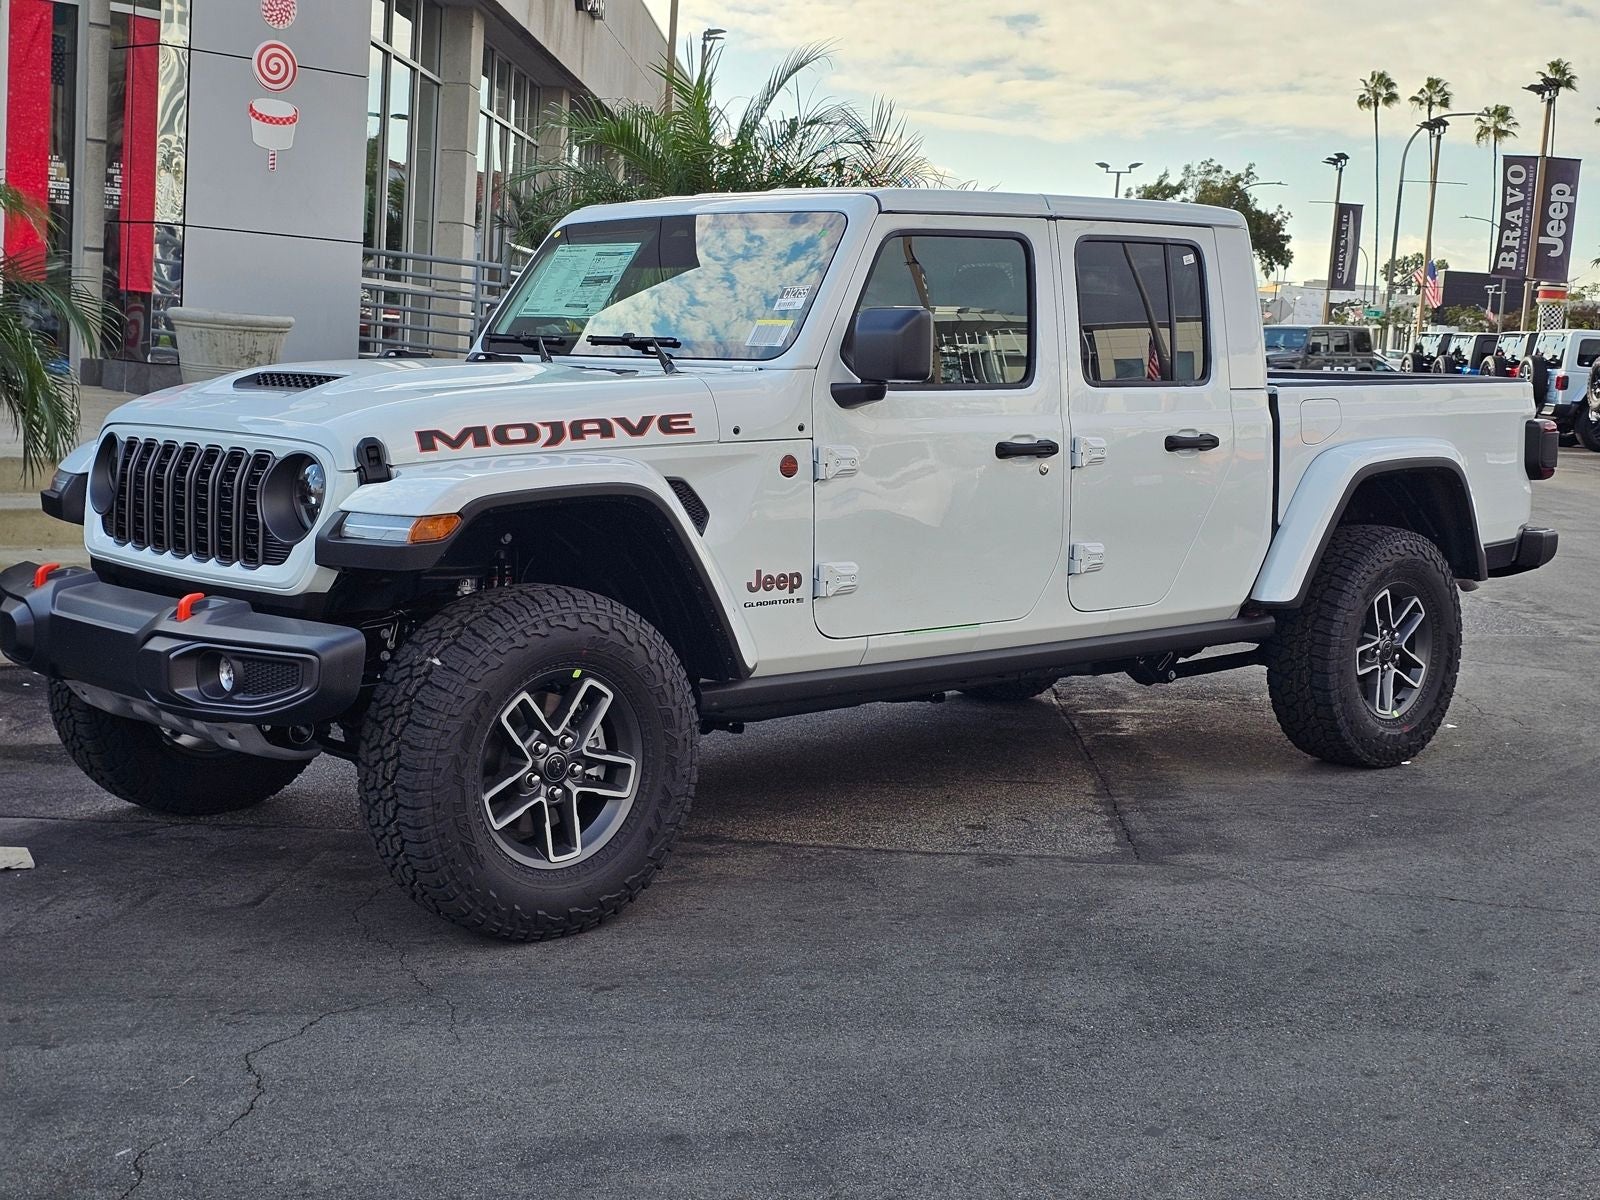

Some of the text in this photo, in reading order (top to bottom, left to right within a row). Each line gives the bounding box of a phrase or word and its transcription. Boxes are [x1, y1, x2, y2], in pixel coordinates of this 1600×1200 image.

[1526, 165, 1536, 211] DEALERSHIP
[1497, 165, 1526, 270] BRAVO
[1524, 214, 1531, 223] OF
[1538, 183, 1575, 258] Jeep
[1337, 214, 1348, 280] CHRYSLER
[415, 412, 696, 453] MOJAVE
[743, 597, 795, 608] GLADIATOR
[746, 569, 803, 594] Jeep
